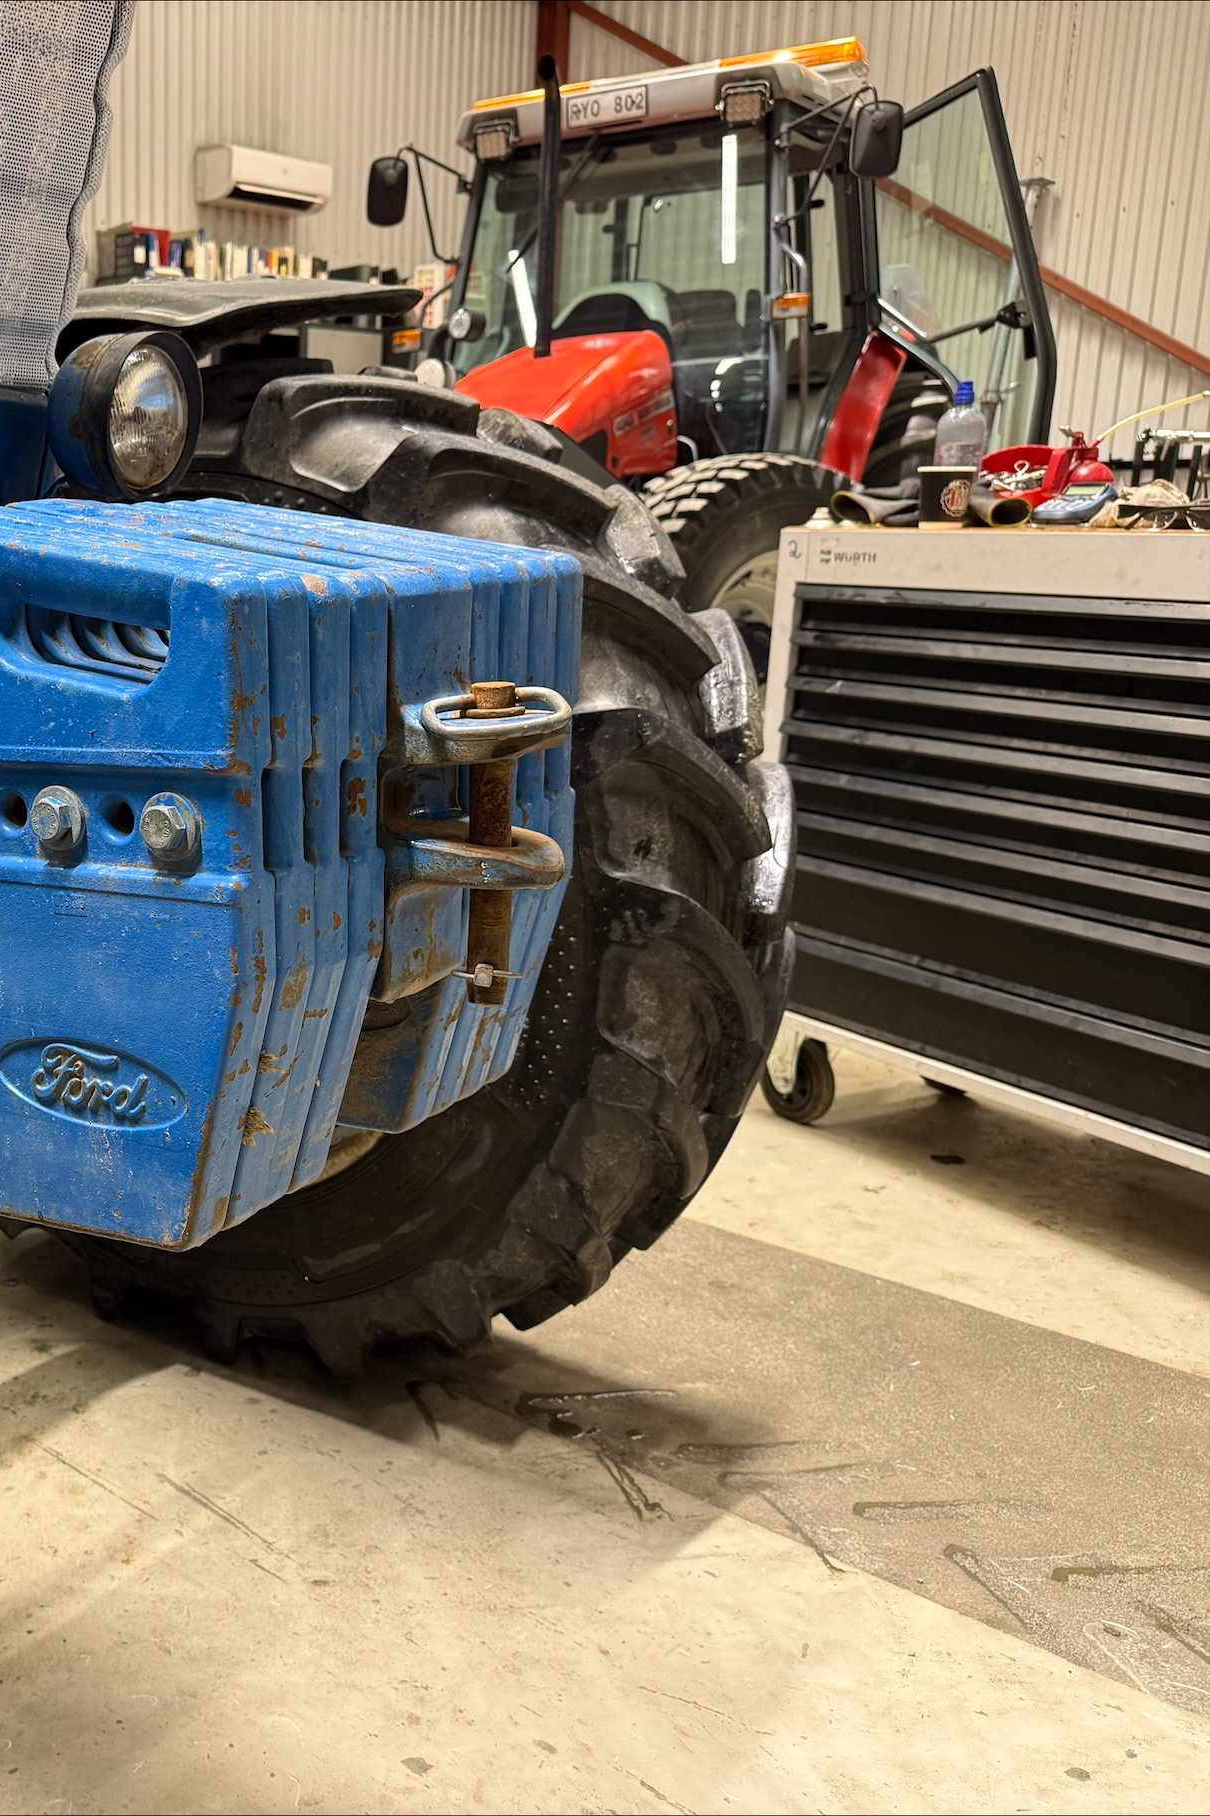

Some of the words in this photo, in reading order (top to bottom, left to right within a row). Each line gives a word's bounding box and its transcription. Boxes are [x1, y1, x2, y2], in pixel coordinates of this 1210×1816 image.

[570, 100, 601, 121] RYO
[614, 92, 644, 114] 802
[31, 1043, 148, 1121] Ford
